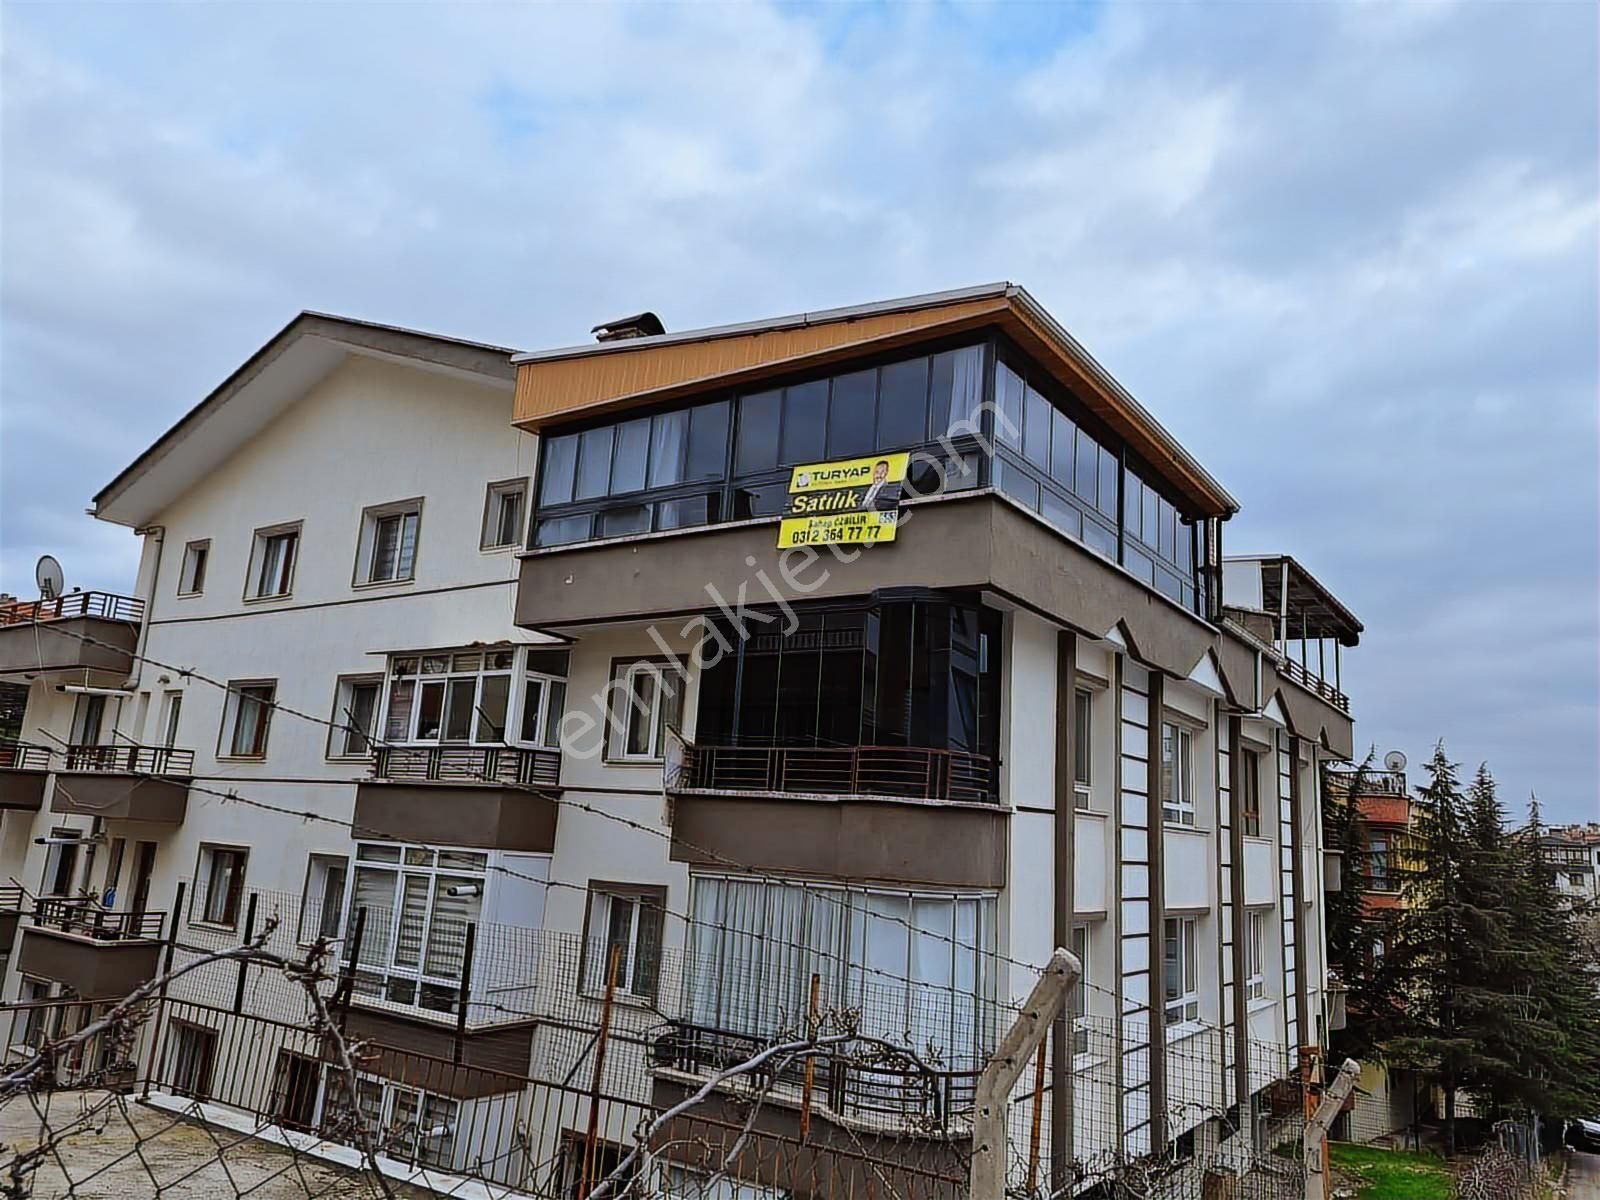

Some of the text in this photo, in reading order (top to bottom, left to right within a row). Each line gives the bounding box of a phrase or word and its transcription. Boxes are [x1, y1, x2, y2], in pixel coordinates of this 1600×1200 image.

[812, 466, 871, 481] TURYAP
[792, 490, 860, 513] Satılık
[792, 525, 881, 544] 0312 364 77 77
